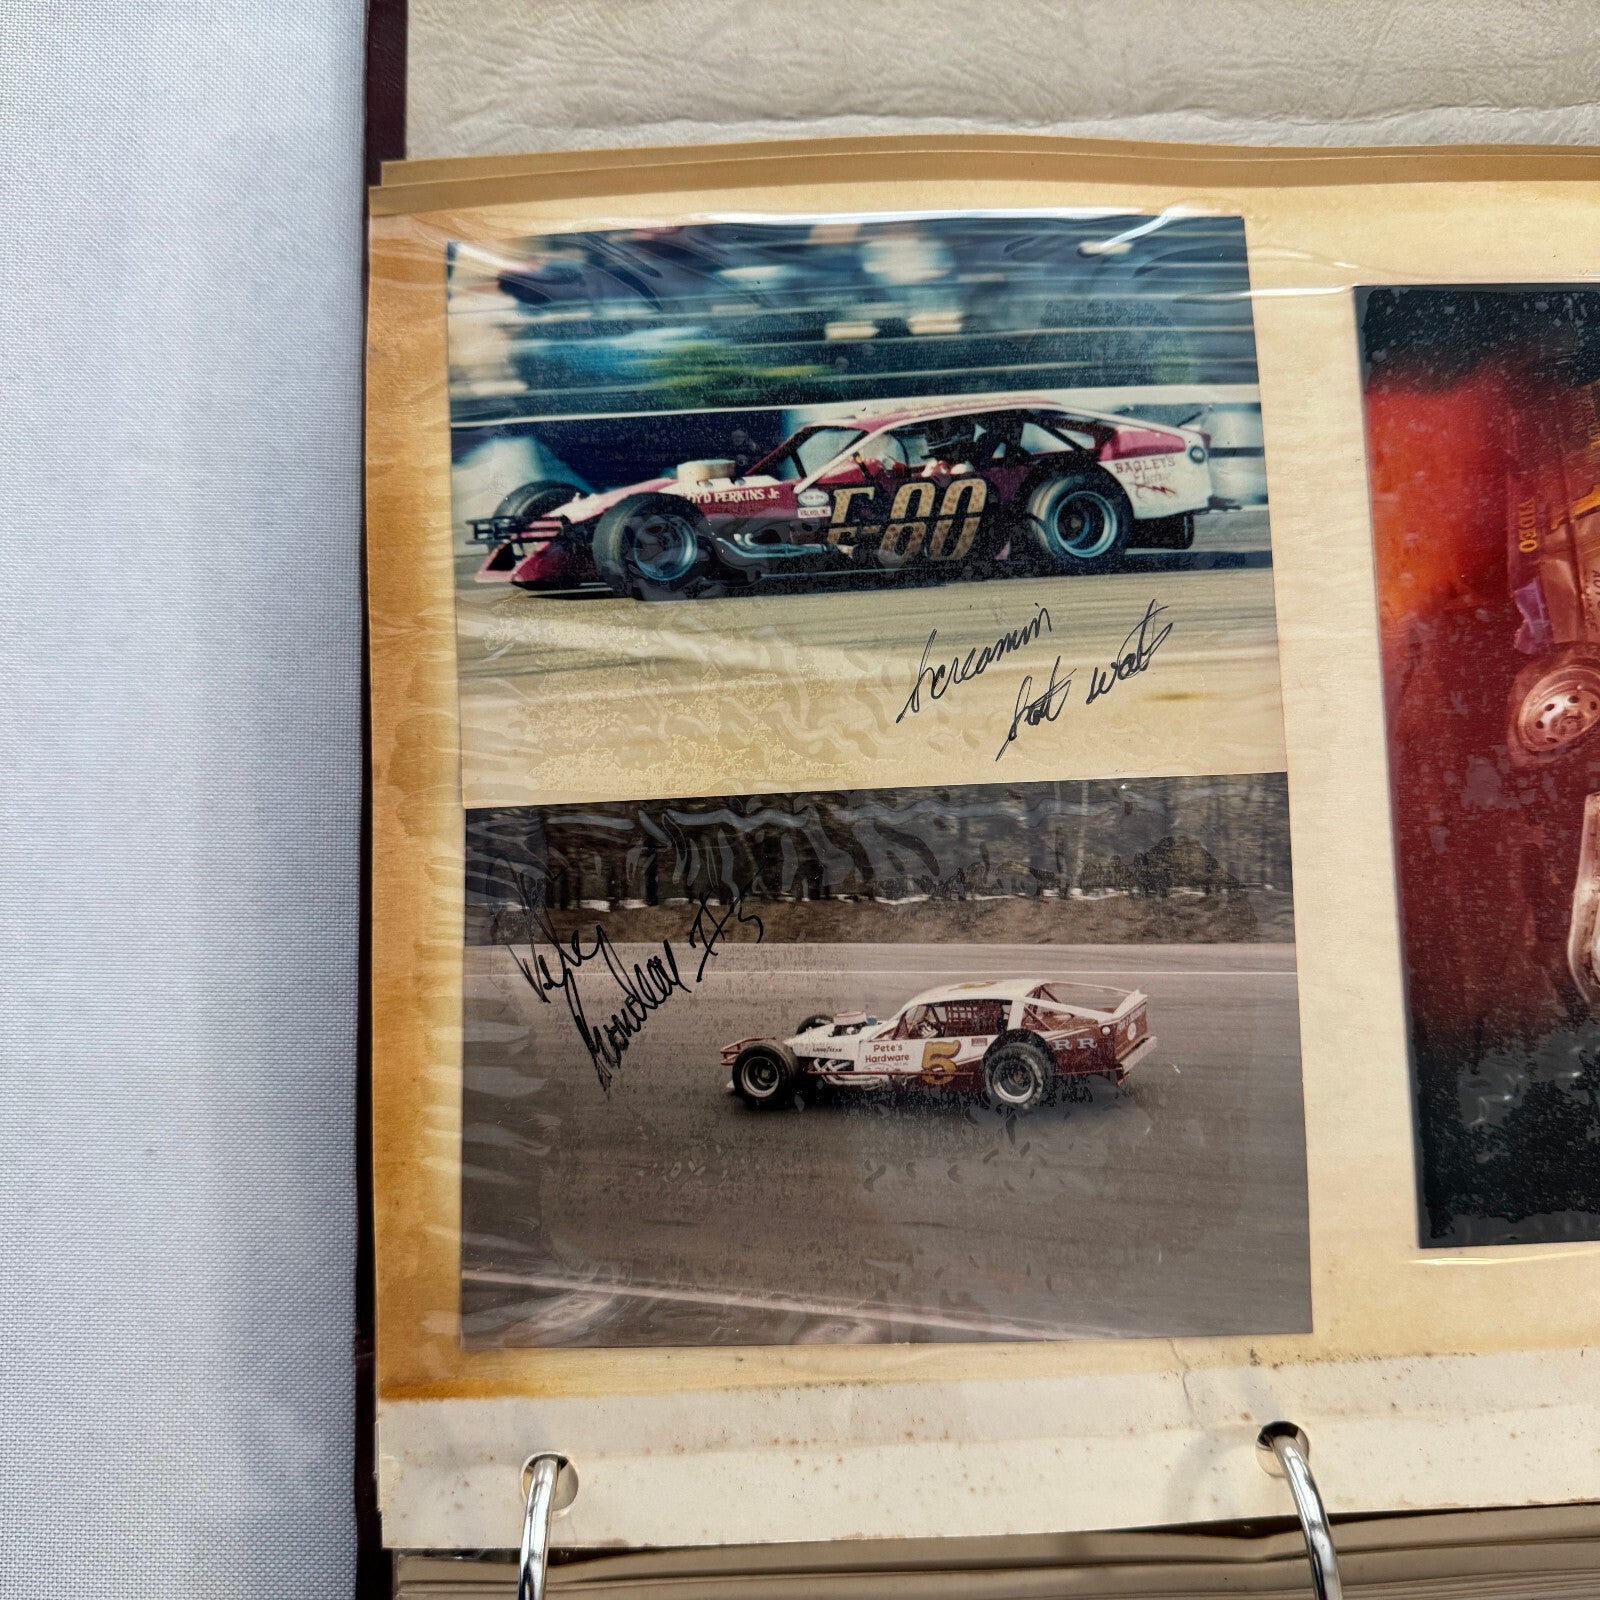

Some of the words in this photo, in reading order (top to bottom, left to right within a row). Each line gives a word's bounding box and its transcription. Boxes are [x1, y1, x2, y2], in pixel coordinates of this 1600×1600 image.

[714, 489, 765, 503] PERKINS
[1517, 497, 1539, 554] VIDEO
[872, 1043, 904, 1053] Pete's
[864, 1053, 911, 1064] Hardware
[920, 1039, 962, 1085] 5
